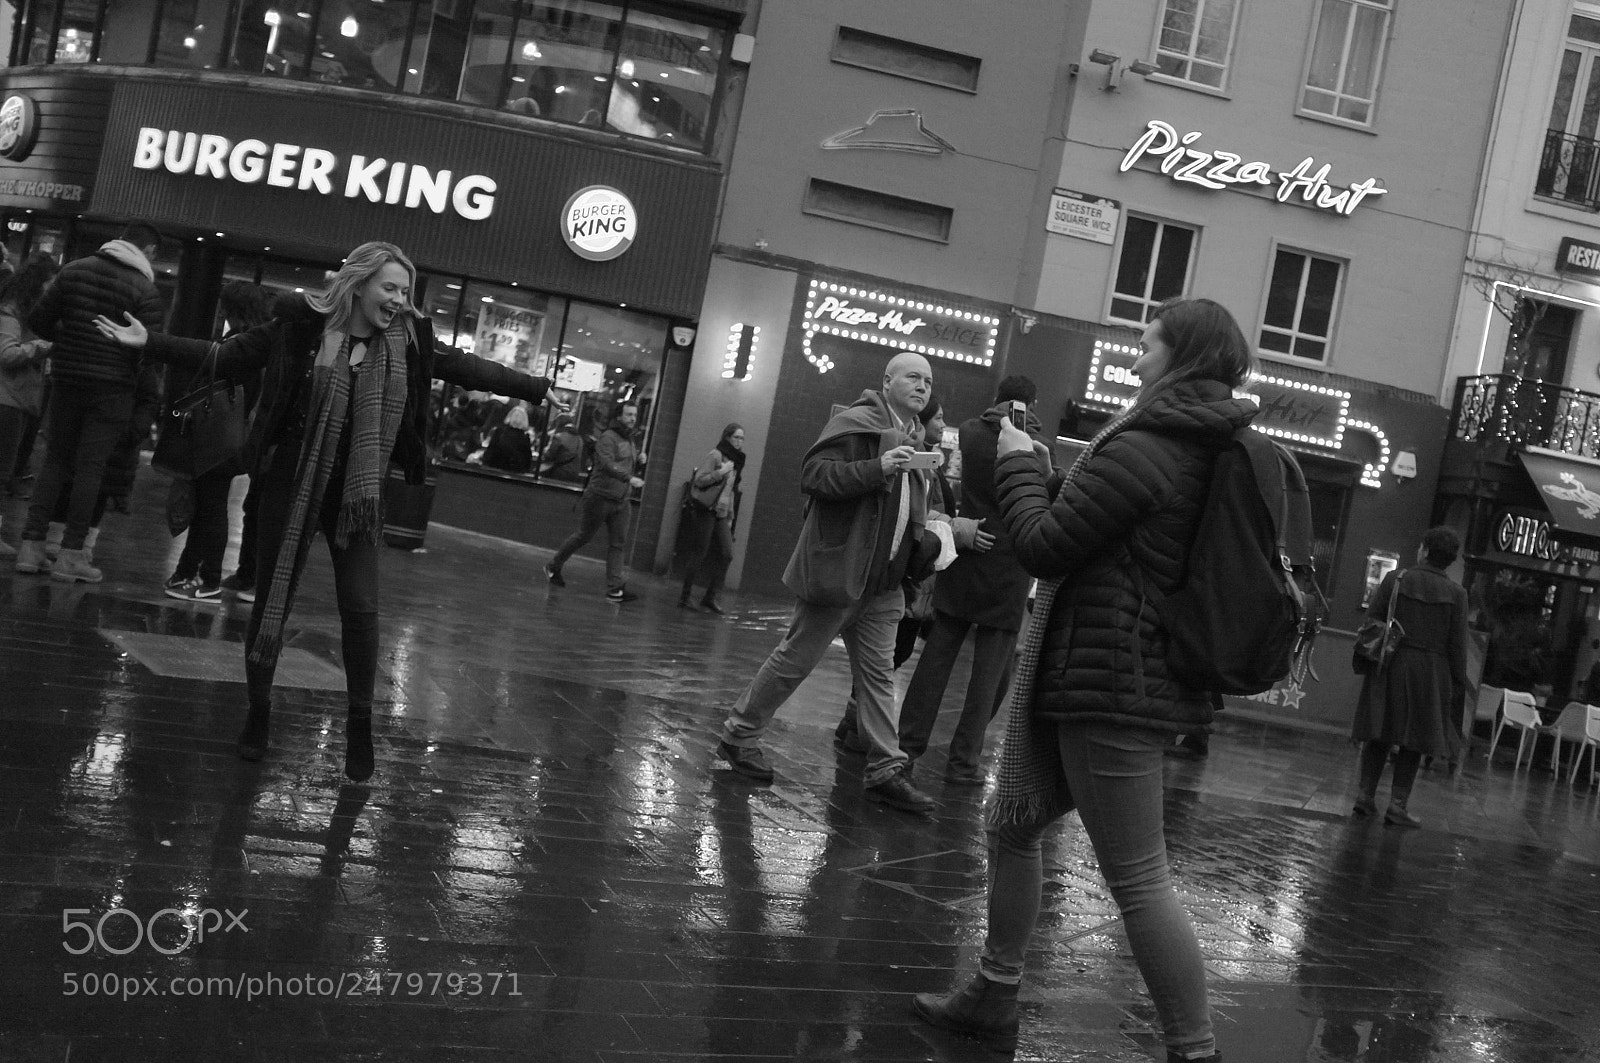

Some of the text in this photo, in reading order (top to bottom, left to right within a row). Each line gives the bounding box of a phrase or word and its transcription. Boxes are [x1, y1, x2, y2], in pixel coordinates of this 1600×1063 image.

[133, 127, 497, 220] BURGER KING
[1120, 120, 1387, 214] Pizza Hut
[16, 180, 82, 201] WHOPPER
[573, 205, 626, 221] BURGER
[1056, 200, 1102, 218] LEICESTER
[573, 217, 626, 239] KING
[1054, 211, 1089, 227] SQUARE
[1092, 219, 1111, 232] WC2
[814, 297, 987, 347] Pizza Hut SLICE
[1103, 364, 1142, 387] COM
